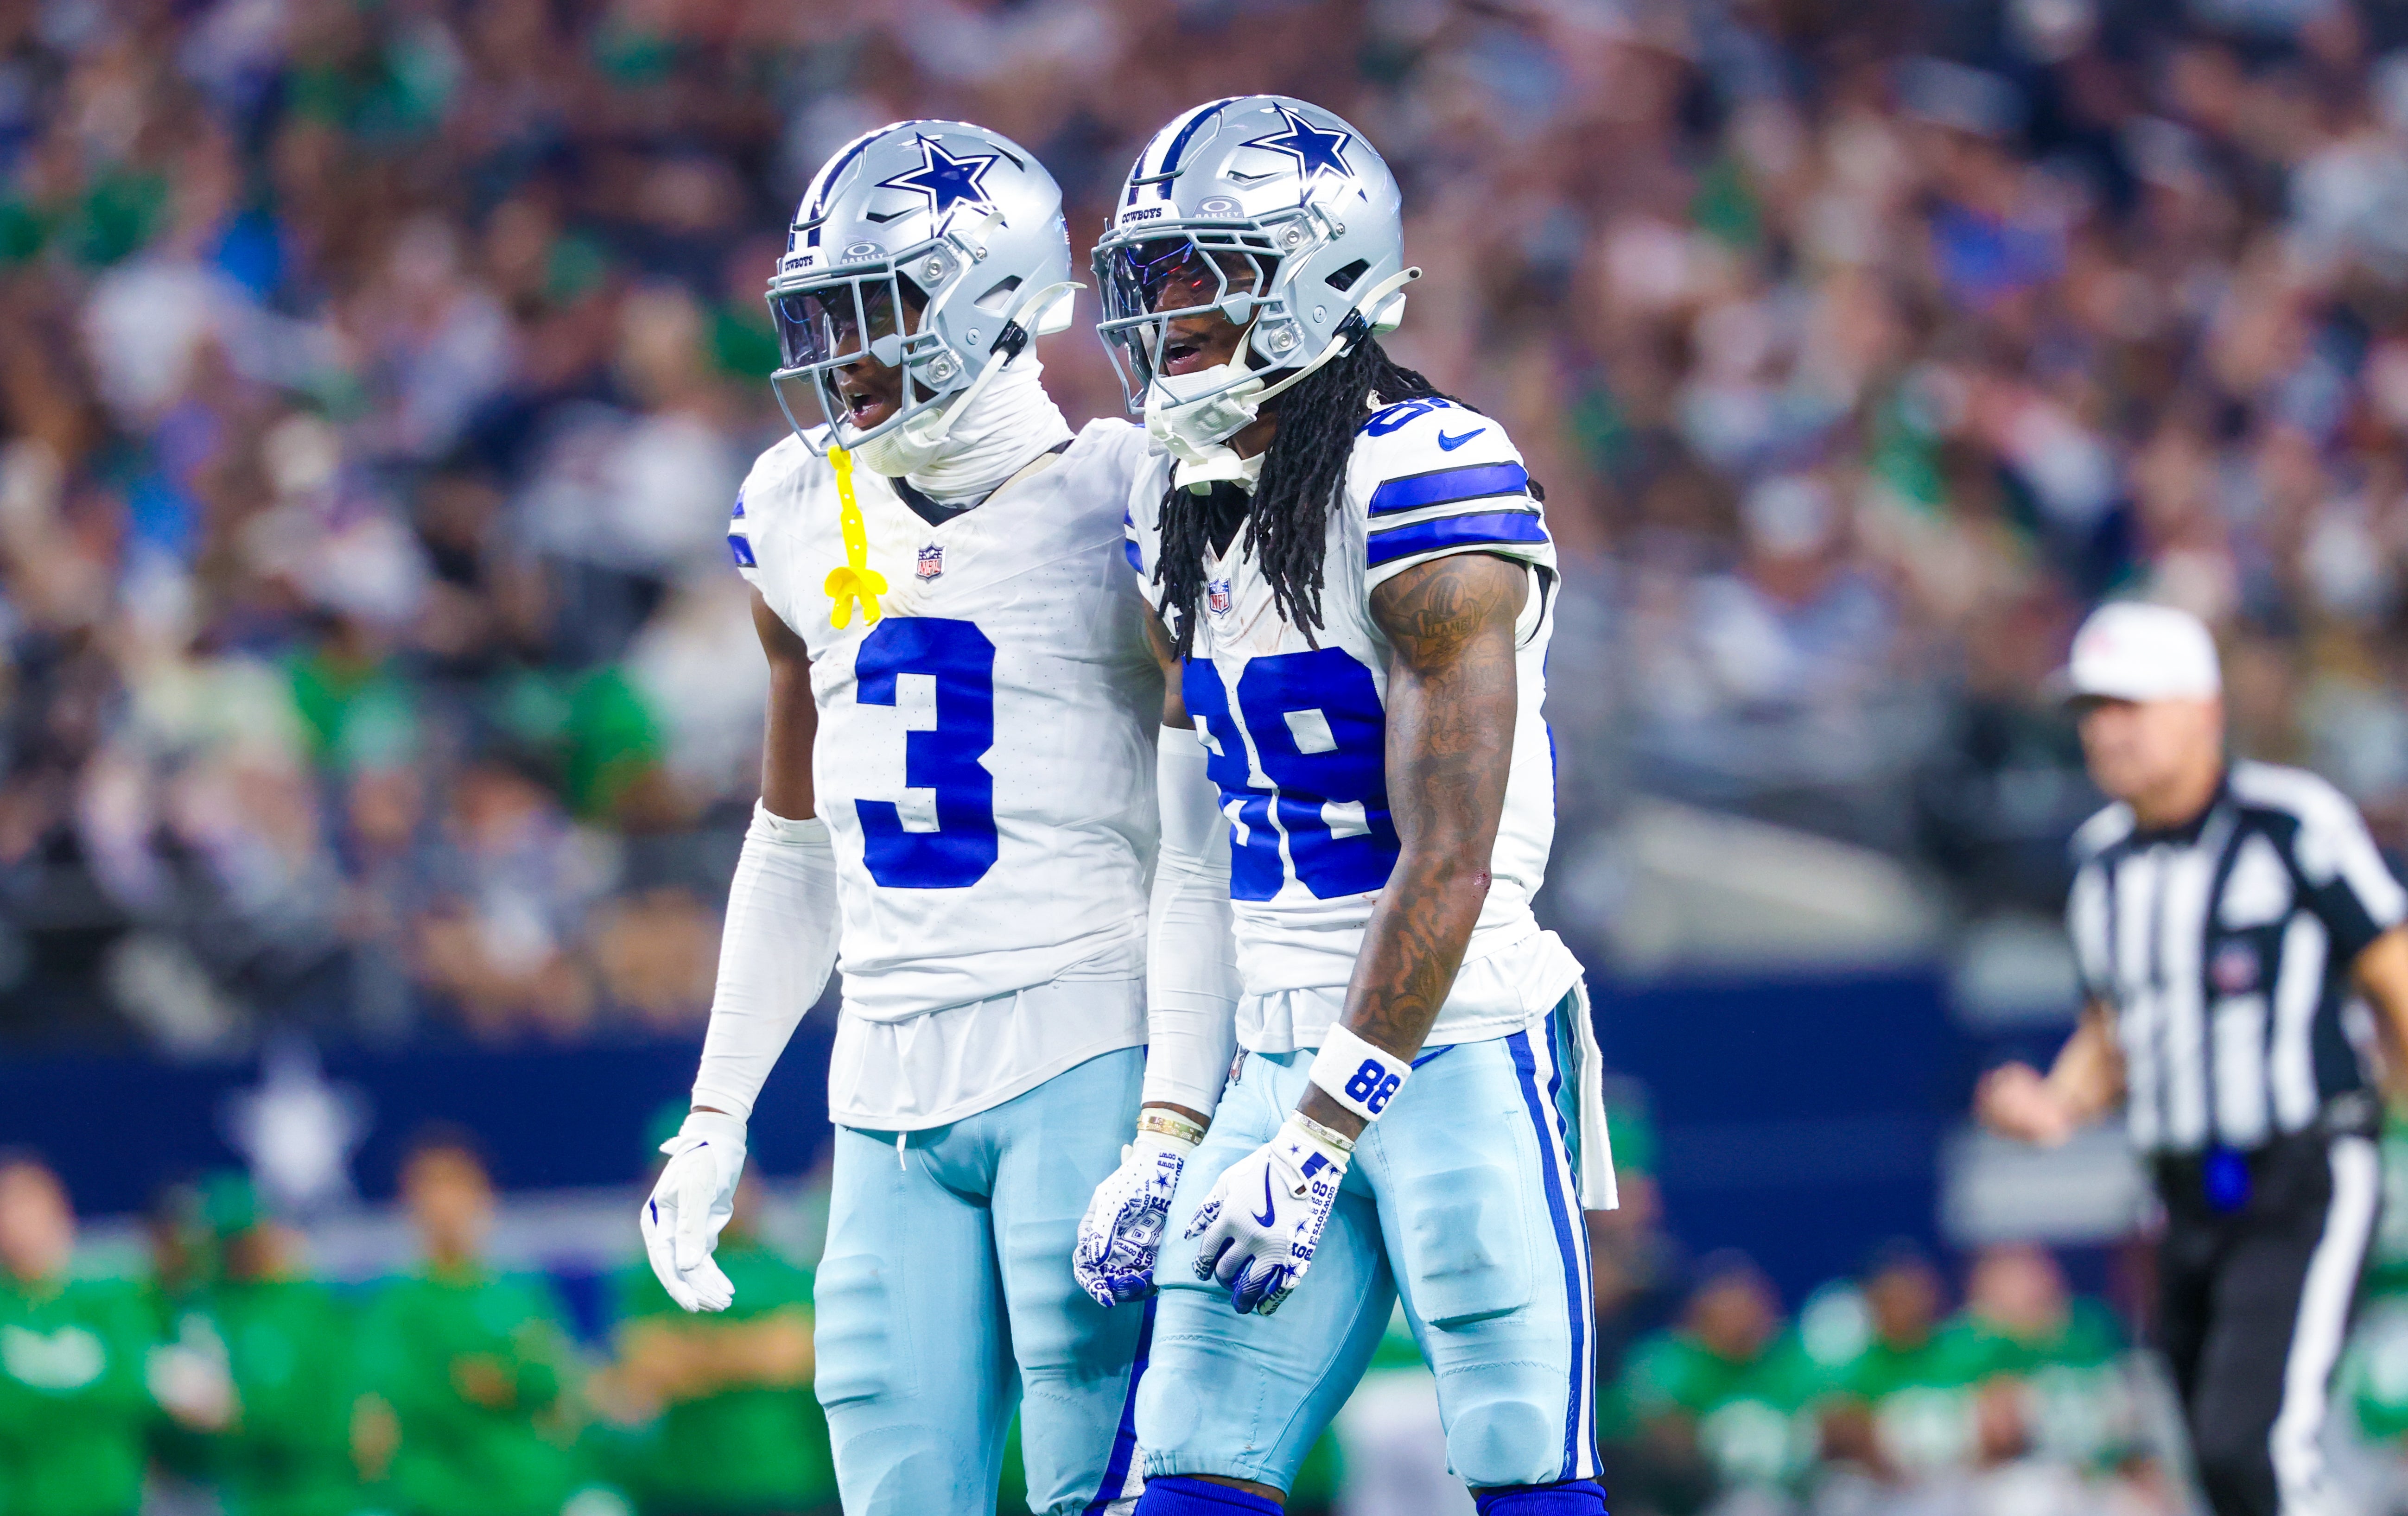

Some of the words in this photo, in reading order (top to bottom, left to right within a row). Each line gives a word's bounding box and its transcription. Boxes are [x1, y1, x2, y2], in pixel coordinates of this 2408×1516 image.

[1122, 208, 1162, 224] COWBOYS
[785, 255, 813, 272] COWBOYS
[842, 253, 884, 264] OAKLEY
[919, 560, 940, 576] NFL
[1211, 594, 1228, 610] NFL
[855, 617, 998, 889] 3
[1182, 646, 1402, 902] 88
[1345, 1059, 1401, 1115] 88
[1312, 1186, 1335, 1235] COWBOYS
